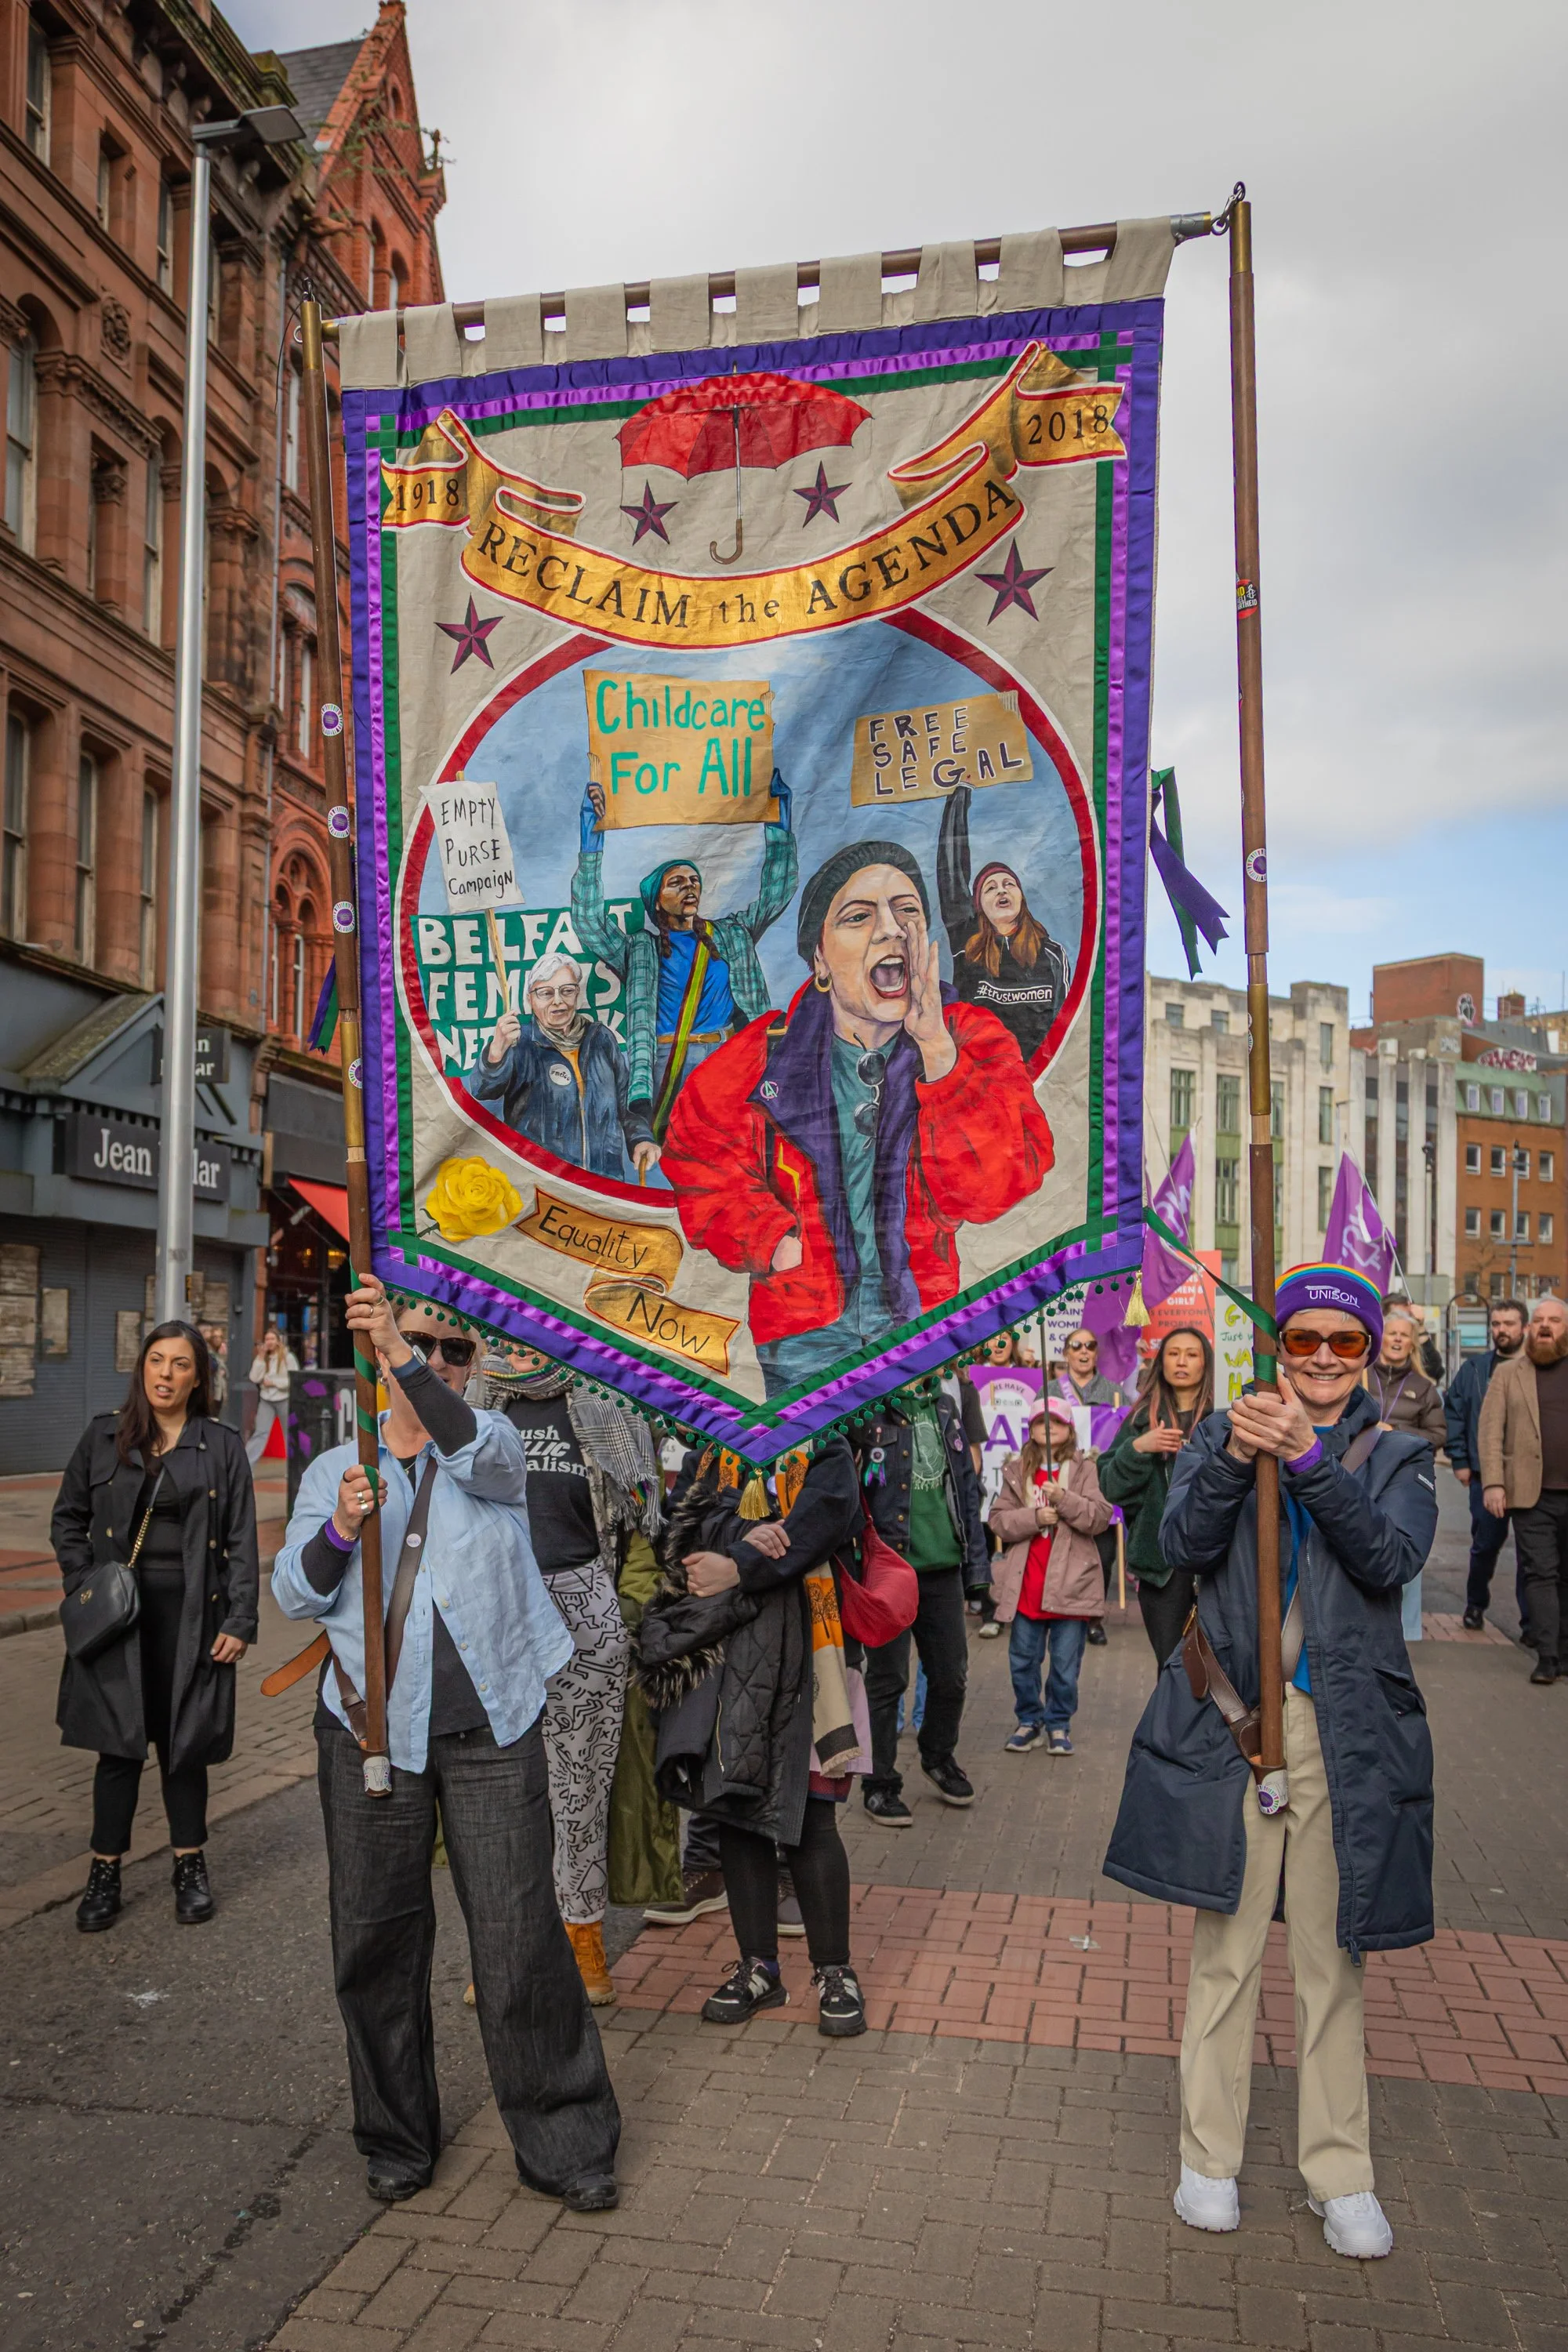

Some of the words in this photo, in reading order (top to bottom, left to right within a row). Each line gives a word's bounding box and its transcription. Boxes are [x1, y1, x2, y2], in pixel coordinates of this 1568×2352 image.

[1026, 405, 1109, 445] 2018
[396, 477, 459, 511] 1918
[477, 521, 691, 628] RECLAIM
[719, 594, 781, 623] the
[806, 479, 1016, 615] AGENDA
[596, 680, 766, 734] Childcare
[868, 706, 969, 743] FREE
[611, 751, 681, 795] For
[697, 736, 753, 798] All
[872, 731, 967, 768] SAFE
[874, 742, 1024, 797] LEGAL
[445, 838, 500, 866] PURSE
[418, 902, 633, 966] BELFAT
[977, 985, 1052, 1002] #trustwomen
[93, 1127, 152, 1177] Jean
[538, 1204, 648, 1269] Equality
[1308, 1290, 1358, 1305] UNISON
